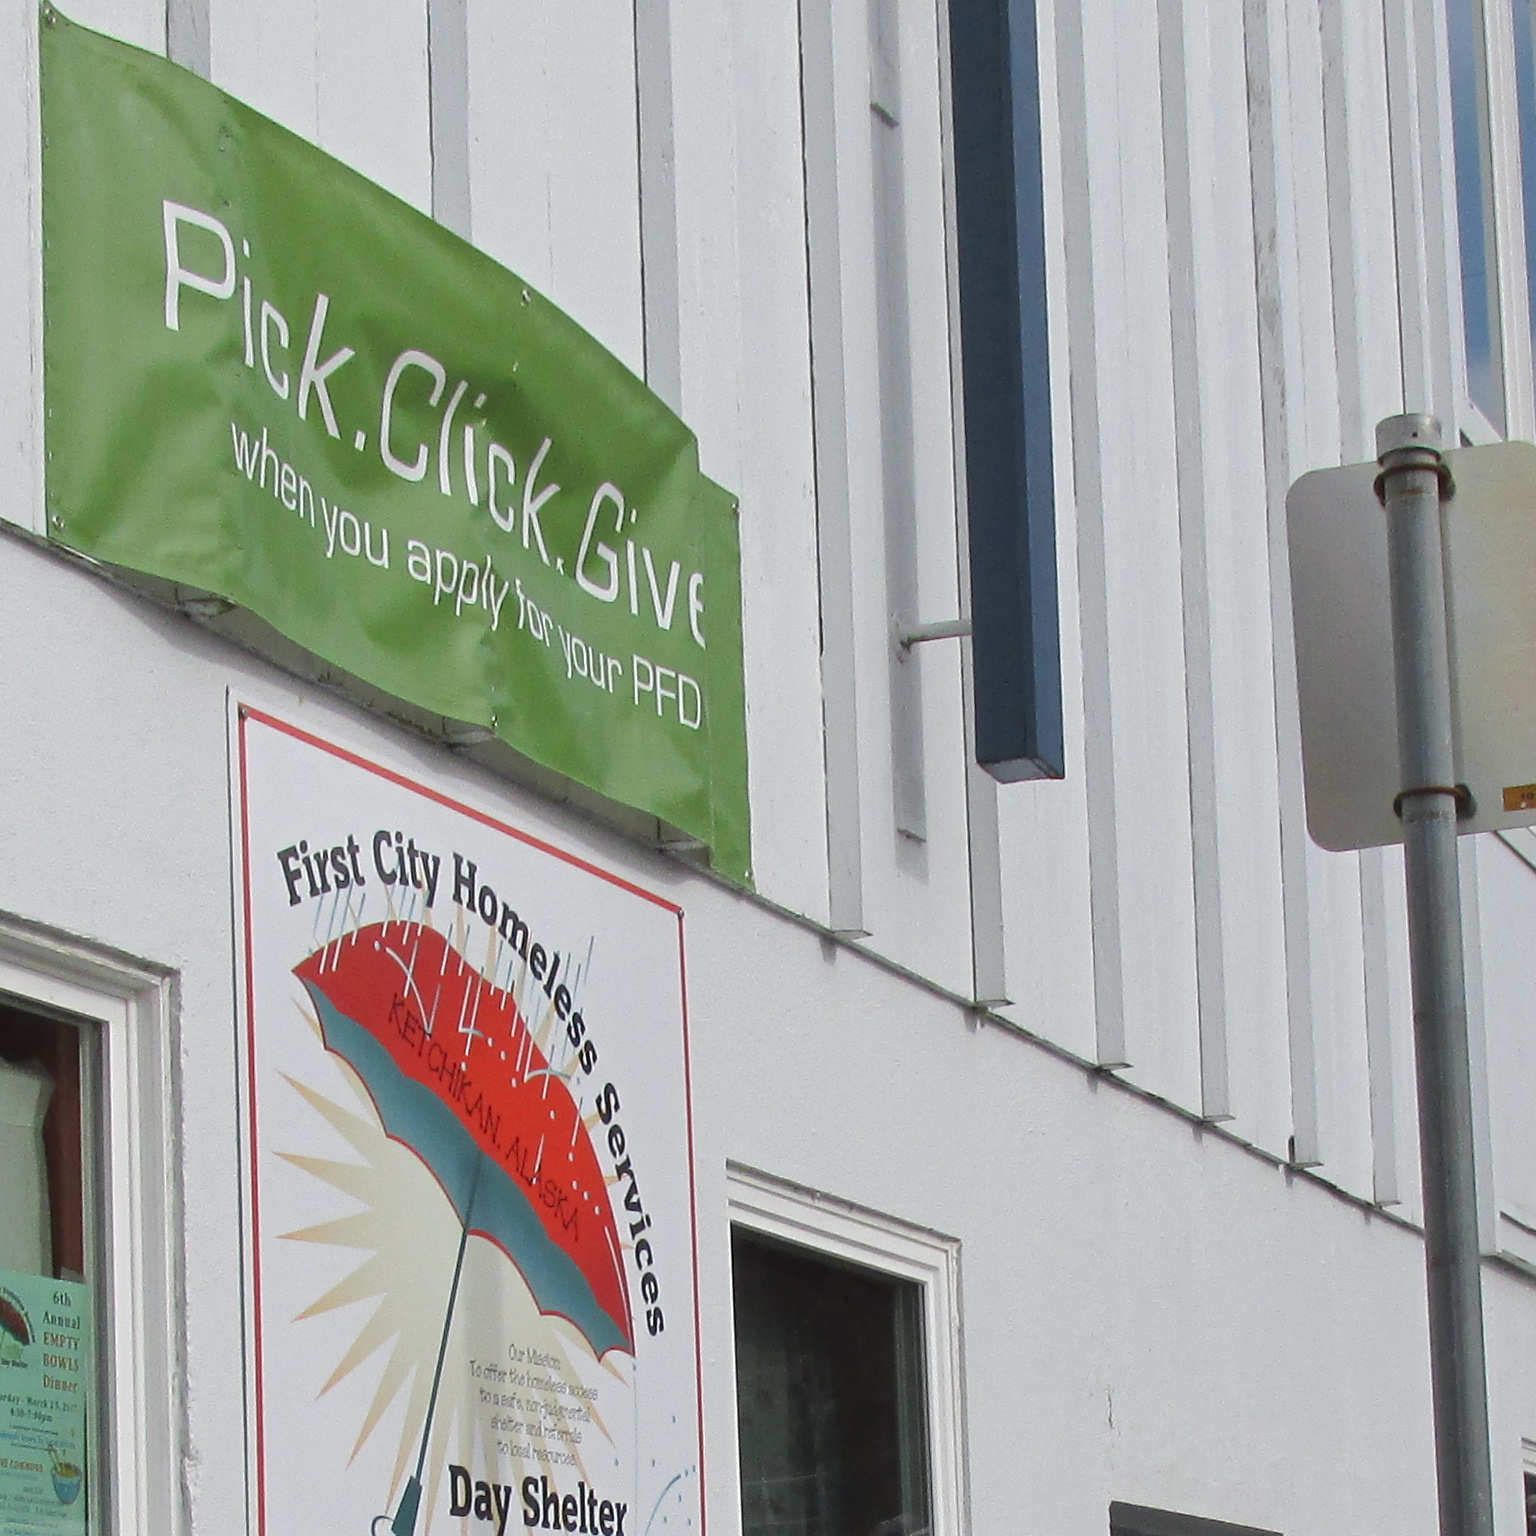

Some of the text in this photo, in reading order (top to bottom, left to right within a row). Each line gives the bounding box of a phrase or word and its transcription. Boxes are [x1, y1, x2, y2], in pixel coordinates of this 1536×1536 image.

[230, 420, 702, 730] when you apply for your PFD
[277, 829, 665, 1338] First City Homeless Services
[505, 1136, 579, 1243] ALASKA
[52, 1291, 72, 1308] 6th
[42, 1310, 80, 1330] Annual
[43, 1331, 80, 1351] EMPTY
[43, 1352, 79, 1373] BOWLS
[508, 1343, 524, 1362] Our
[42, 1373, 78, 1394] Dinner
[469, 1359, 482, 1378] To
[484, 1363, 507, 1383] offer
[509, 1367, 524, 1387] the
[526, 1371, 567, 1394] homeless
[479, 1387, 492, 1402] to
[493, 1391, 499, 1406] a
[491, 1413, 582, 1444] shelter and referrals
[497, 1439, 508, 1455] to
[510, 1440, 530, 1459] local
